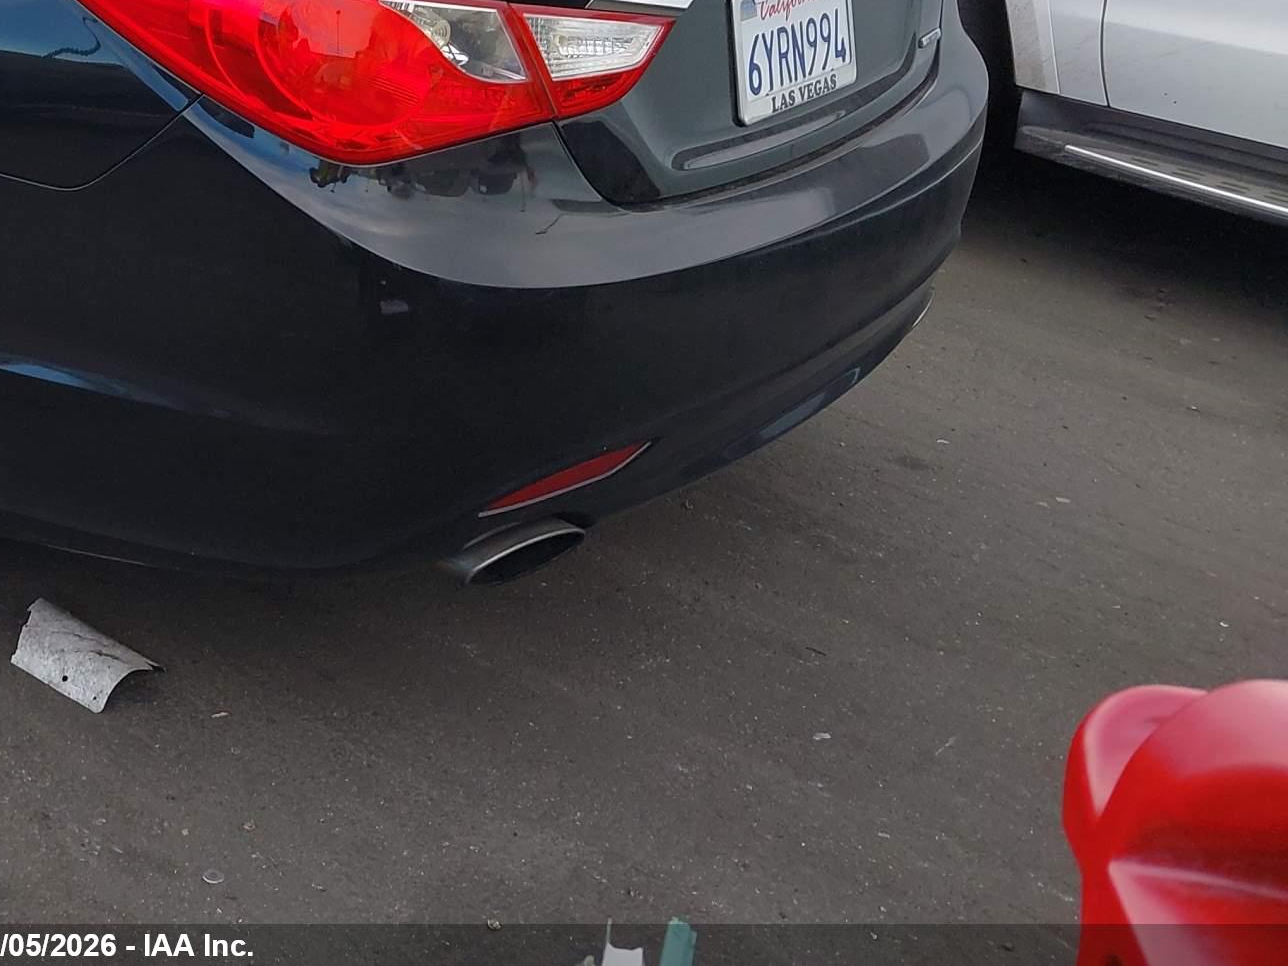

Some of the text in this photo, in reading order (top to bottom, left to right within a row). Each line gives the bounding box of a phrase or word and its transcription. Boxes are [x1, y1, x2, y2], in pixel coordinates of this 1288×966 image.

[748, 8, 847, 96] 6YRN994
[771, 73, 837, 114] LAS VEGAS
